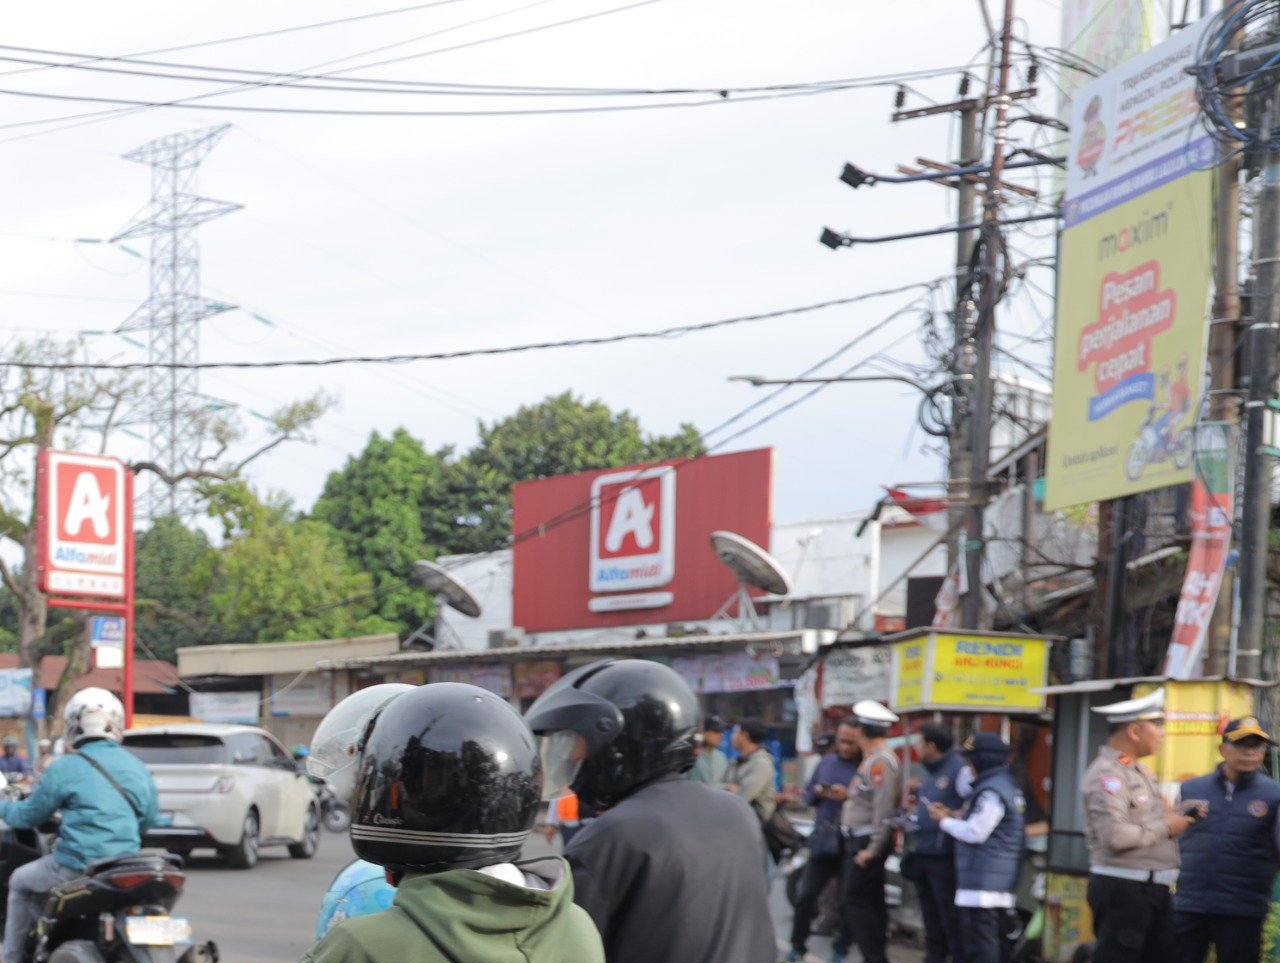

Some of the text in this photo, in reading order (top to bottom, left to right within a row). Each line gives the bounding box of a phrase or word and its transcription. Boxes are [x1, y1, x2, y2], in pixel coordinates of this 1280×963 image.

[1102, 269, 1155, 311] Pesan
[1080, 298, 1172, 360] perjalanan
[1098, 340, 1146, 383] cepat
